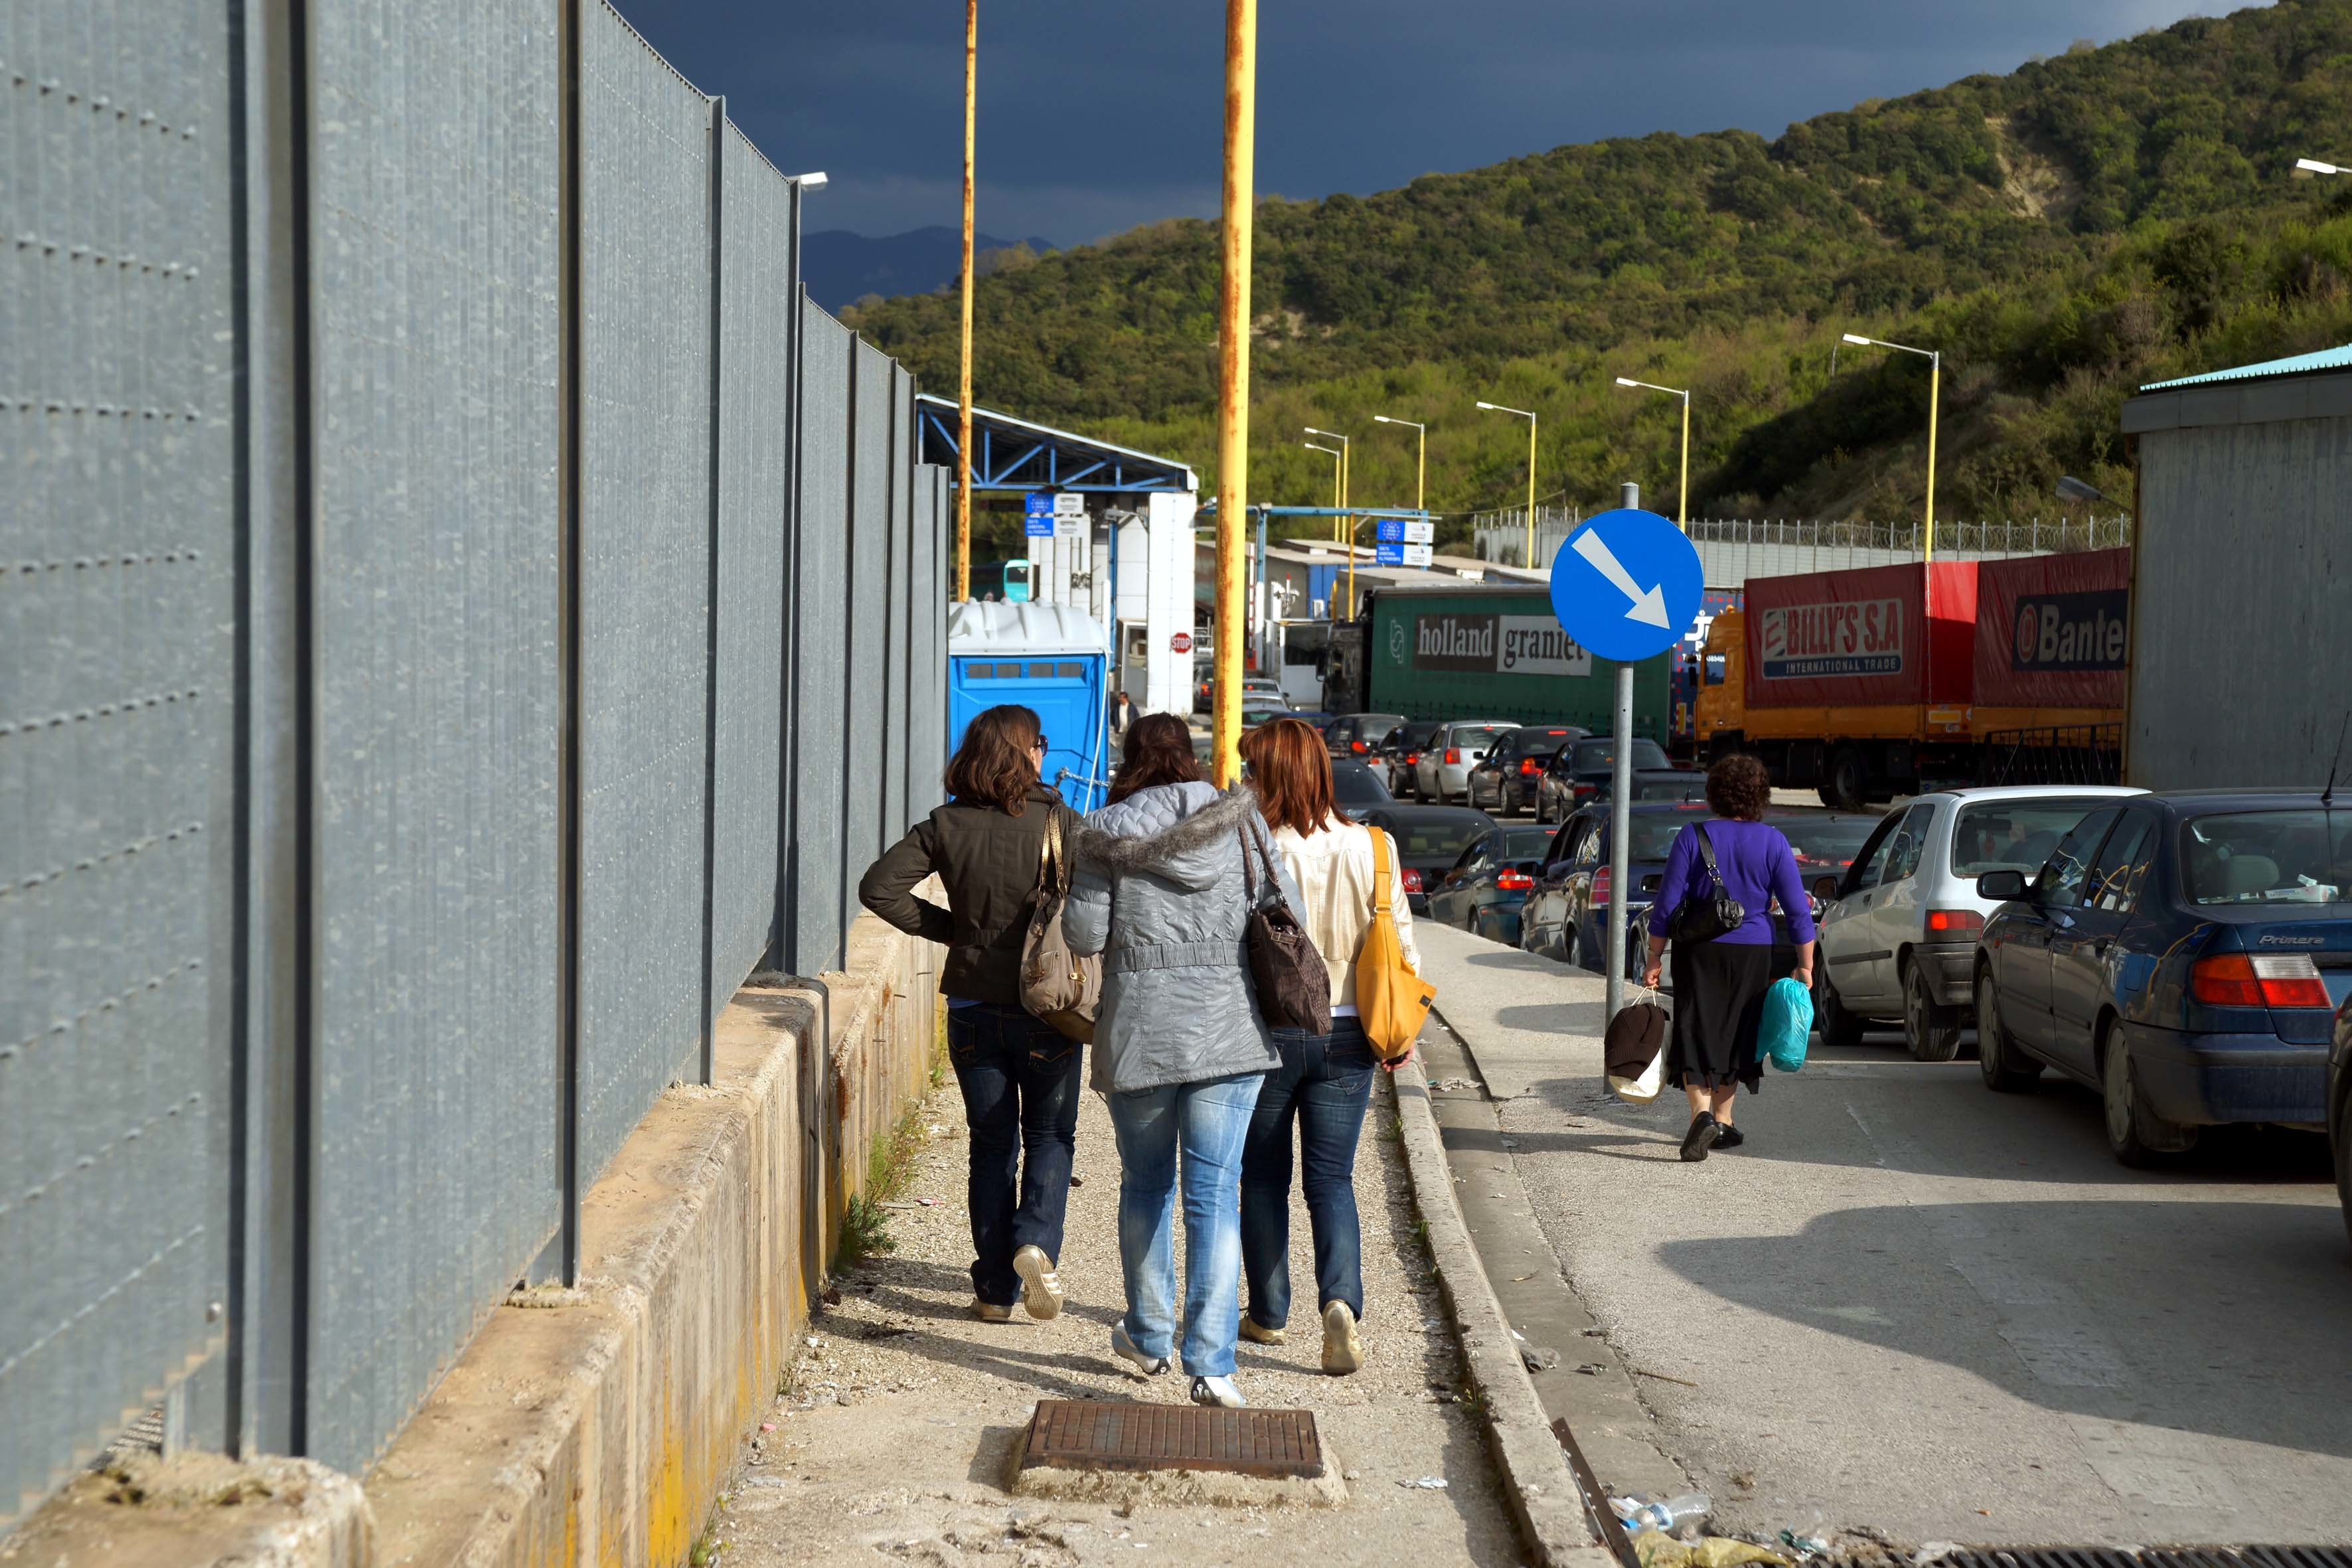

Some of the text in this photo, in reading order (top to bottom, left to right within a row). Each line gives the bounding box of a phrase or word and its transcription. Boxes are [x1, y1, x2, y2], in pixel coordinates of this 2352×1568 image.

[1786, 601, 1900, 655] BILLY'S S.A
[1171, 637, 1190, 649] STOP
[1417, 618, 1494, 658] holland
[1786, 657, 1897, 674] INTERNATIONAL TRADE
[2259, 935, 2325, 945] Primera
